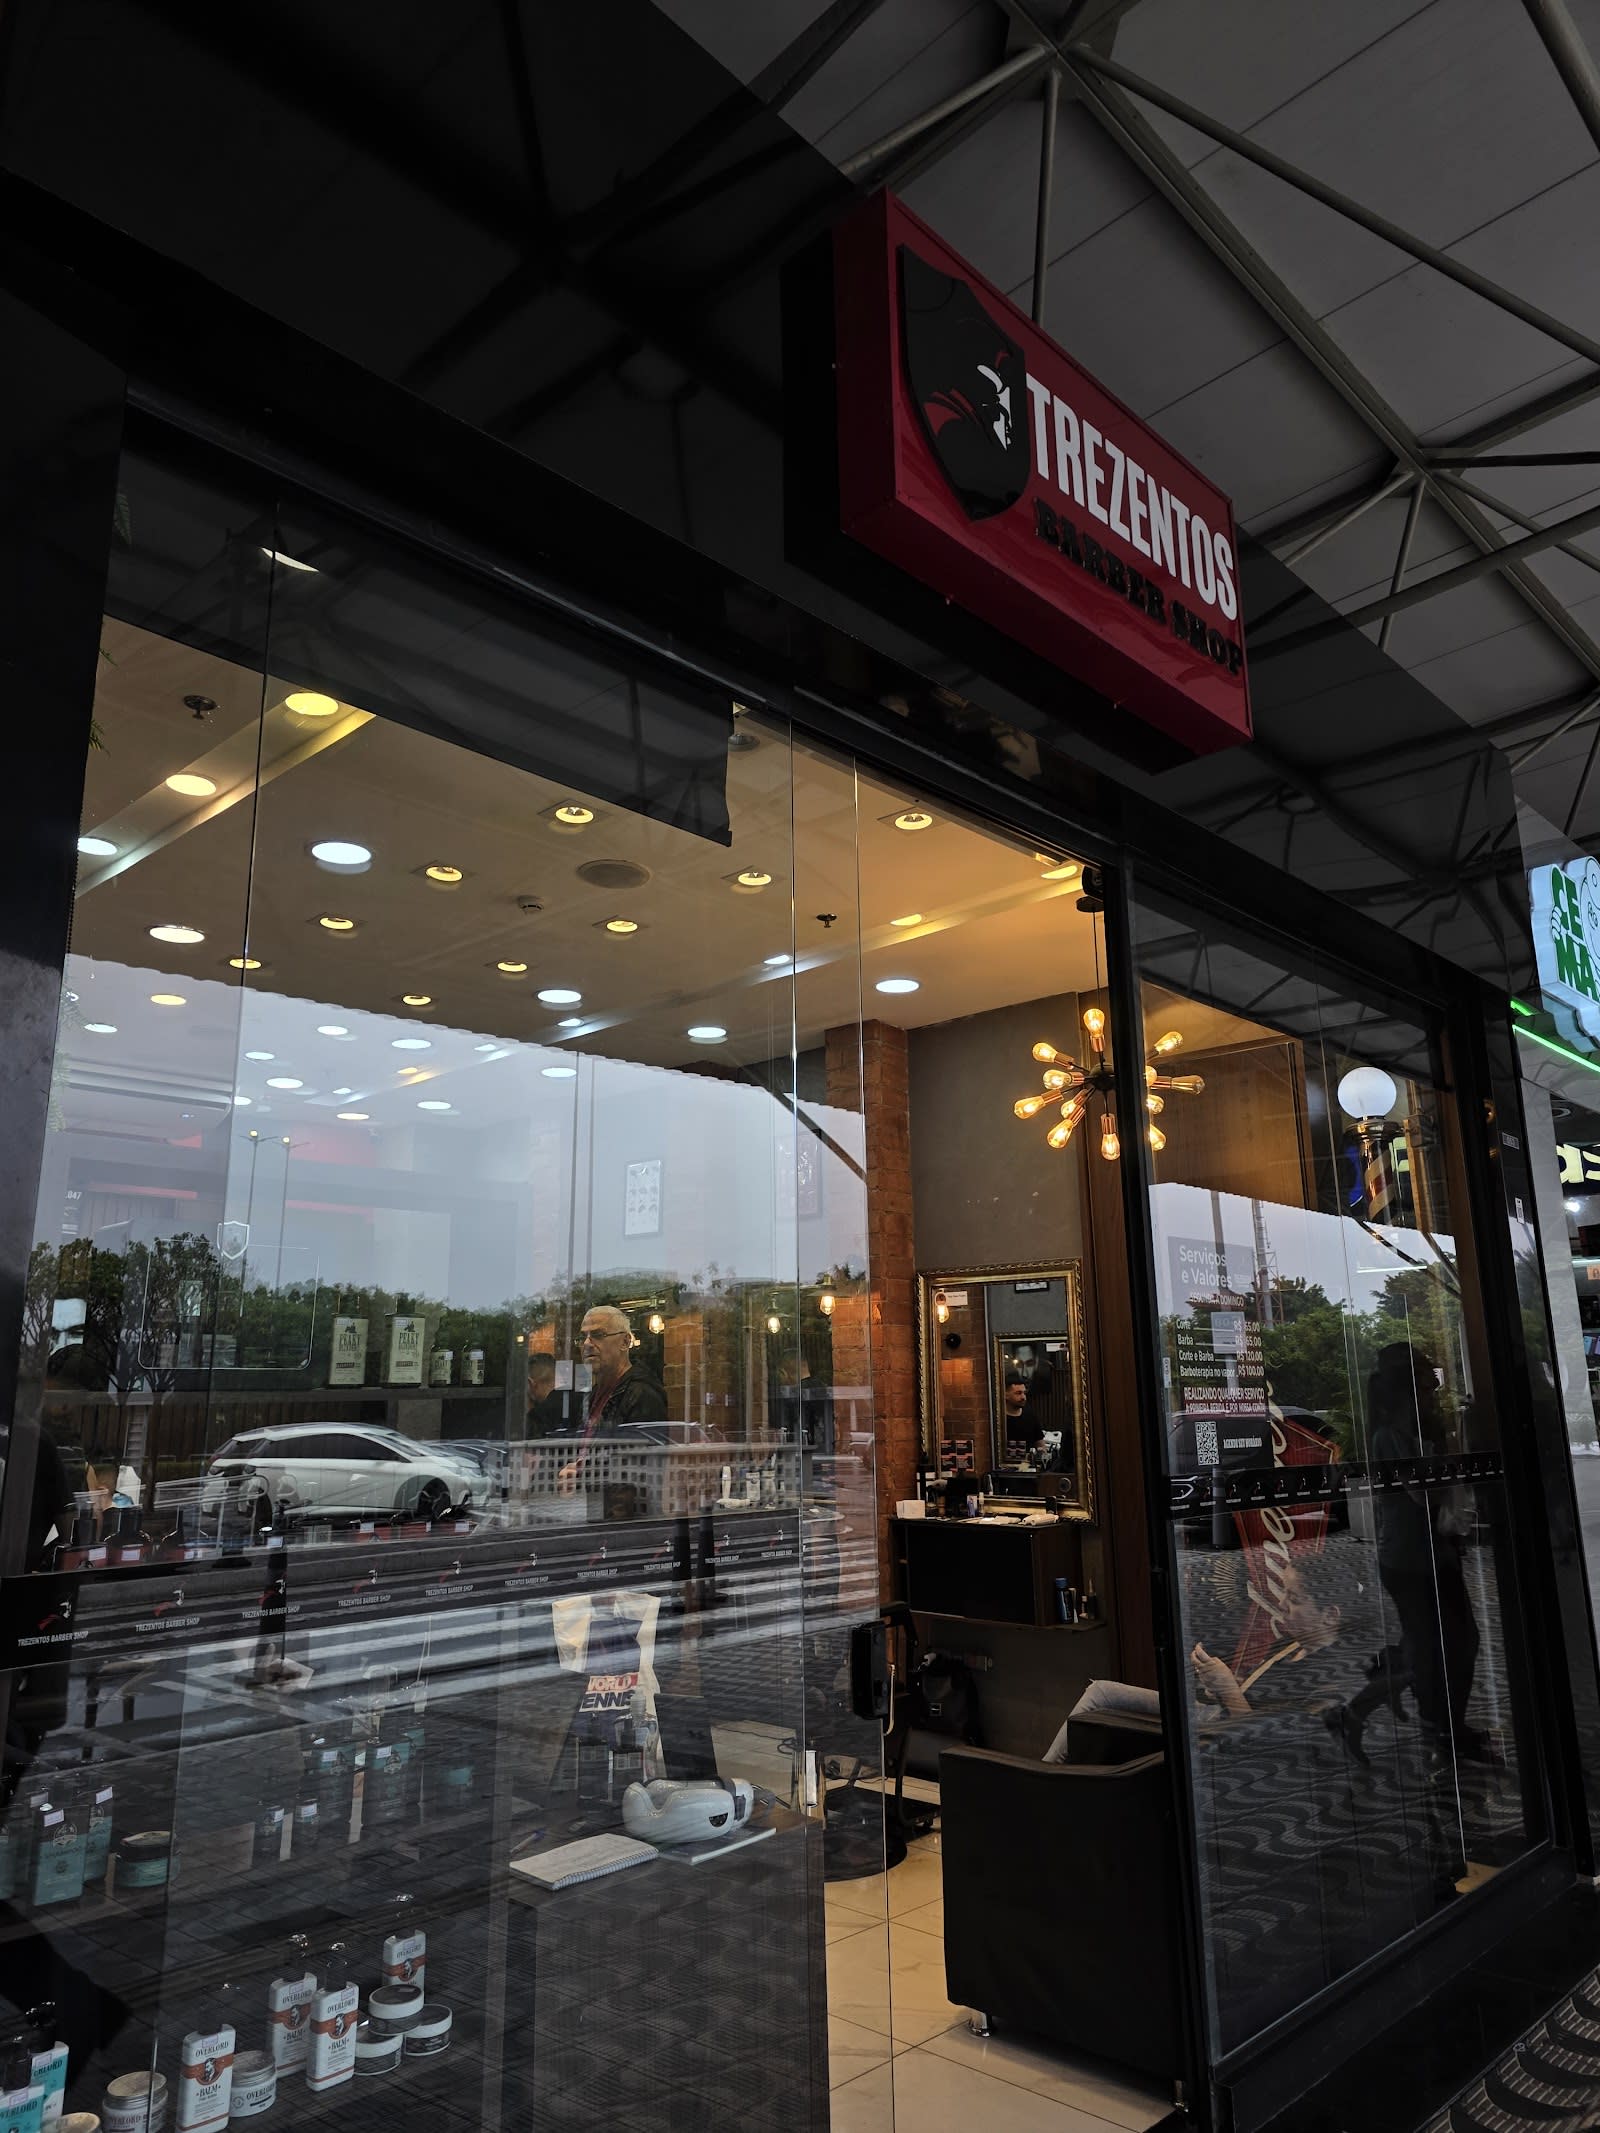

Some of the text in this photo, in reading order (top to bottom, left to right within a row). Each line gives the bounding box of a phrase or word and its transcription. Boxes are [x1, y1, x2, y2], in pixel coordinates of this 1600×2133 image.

[1026, 372, 1238, 620] TREZENTOS
[1034, 497, 1242, 676] BARBER SHOP
[1179, 1245, 1227, 1269] Serviços
[1182, 1267, 1232, 1288] e Valores
[1176, 1319, 1191, 1330] Corte
[1177, 1334, 1194, 1346] Barba
[1178, 1350, 1194, 1361] Corte
[1198, 1350, 1215, 1361] Barba
[1214, 1368, 1221, 1377] no
[1184, 1387, 1217, 1400] REALIZANDO
[136, 1617, 200, 1632] TREZENTOS BARBER SHOP
[17, 1630, 89, 1647] TREZENTOS BARBER SHOP
[328, 1997, 356, 2014] OVERLORD
[195, 2040, 229, 2058] OVERLORD
[331, 2037, 347, 2050] BALM
[199, 2084, 218, 2098] BALM
[0, 2100, 38, 2120] VERLORD
